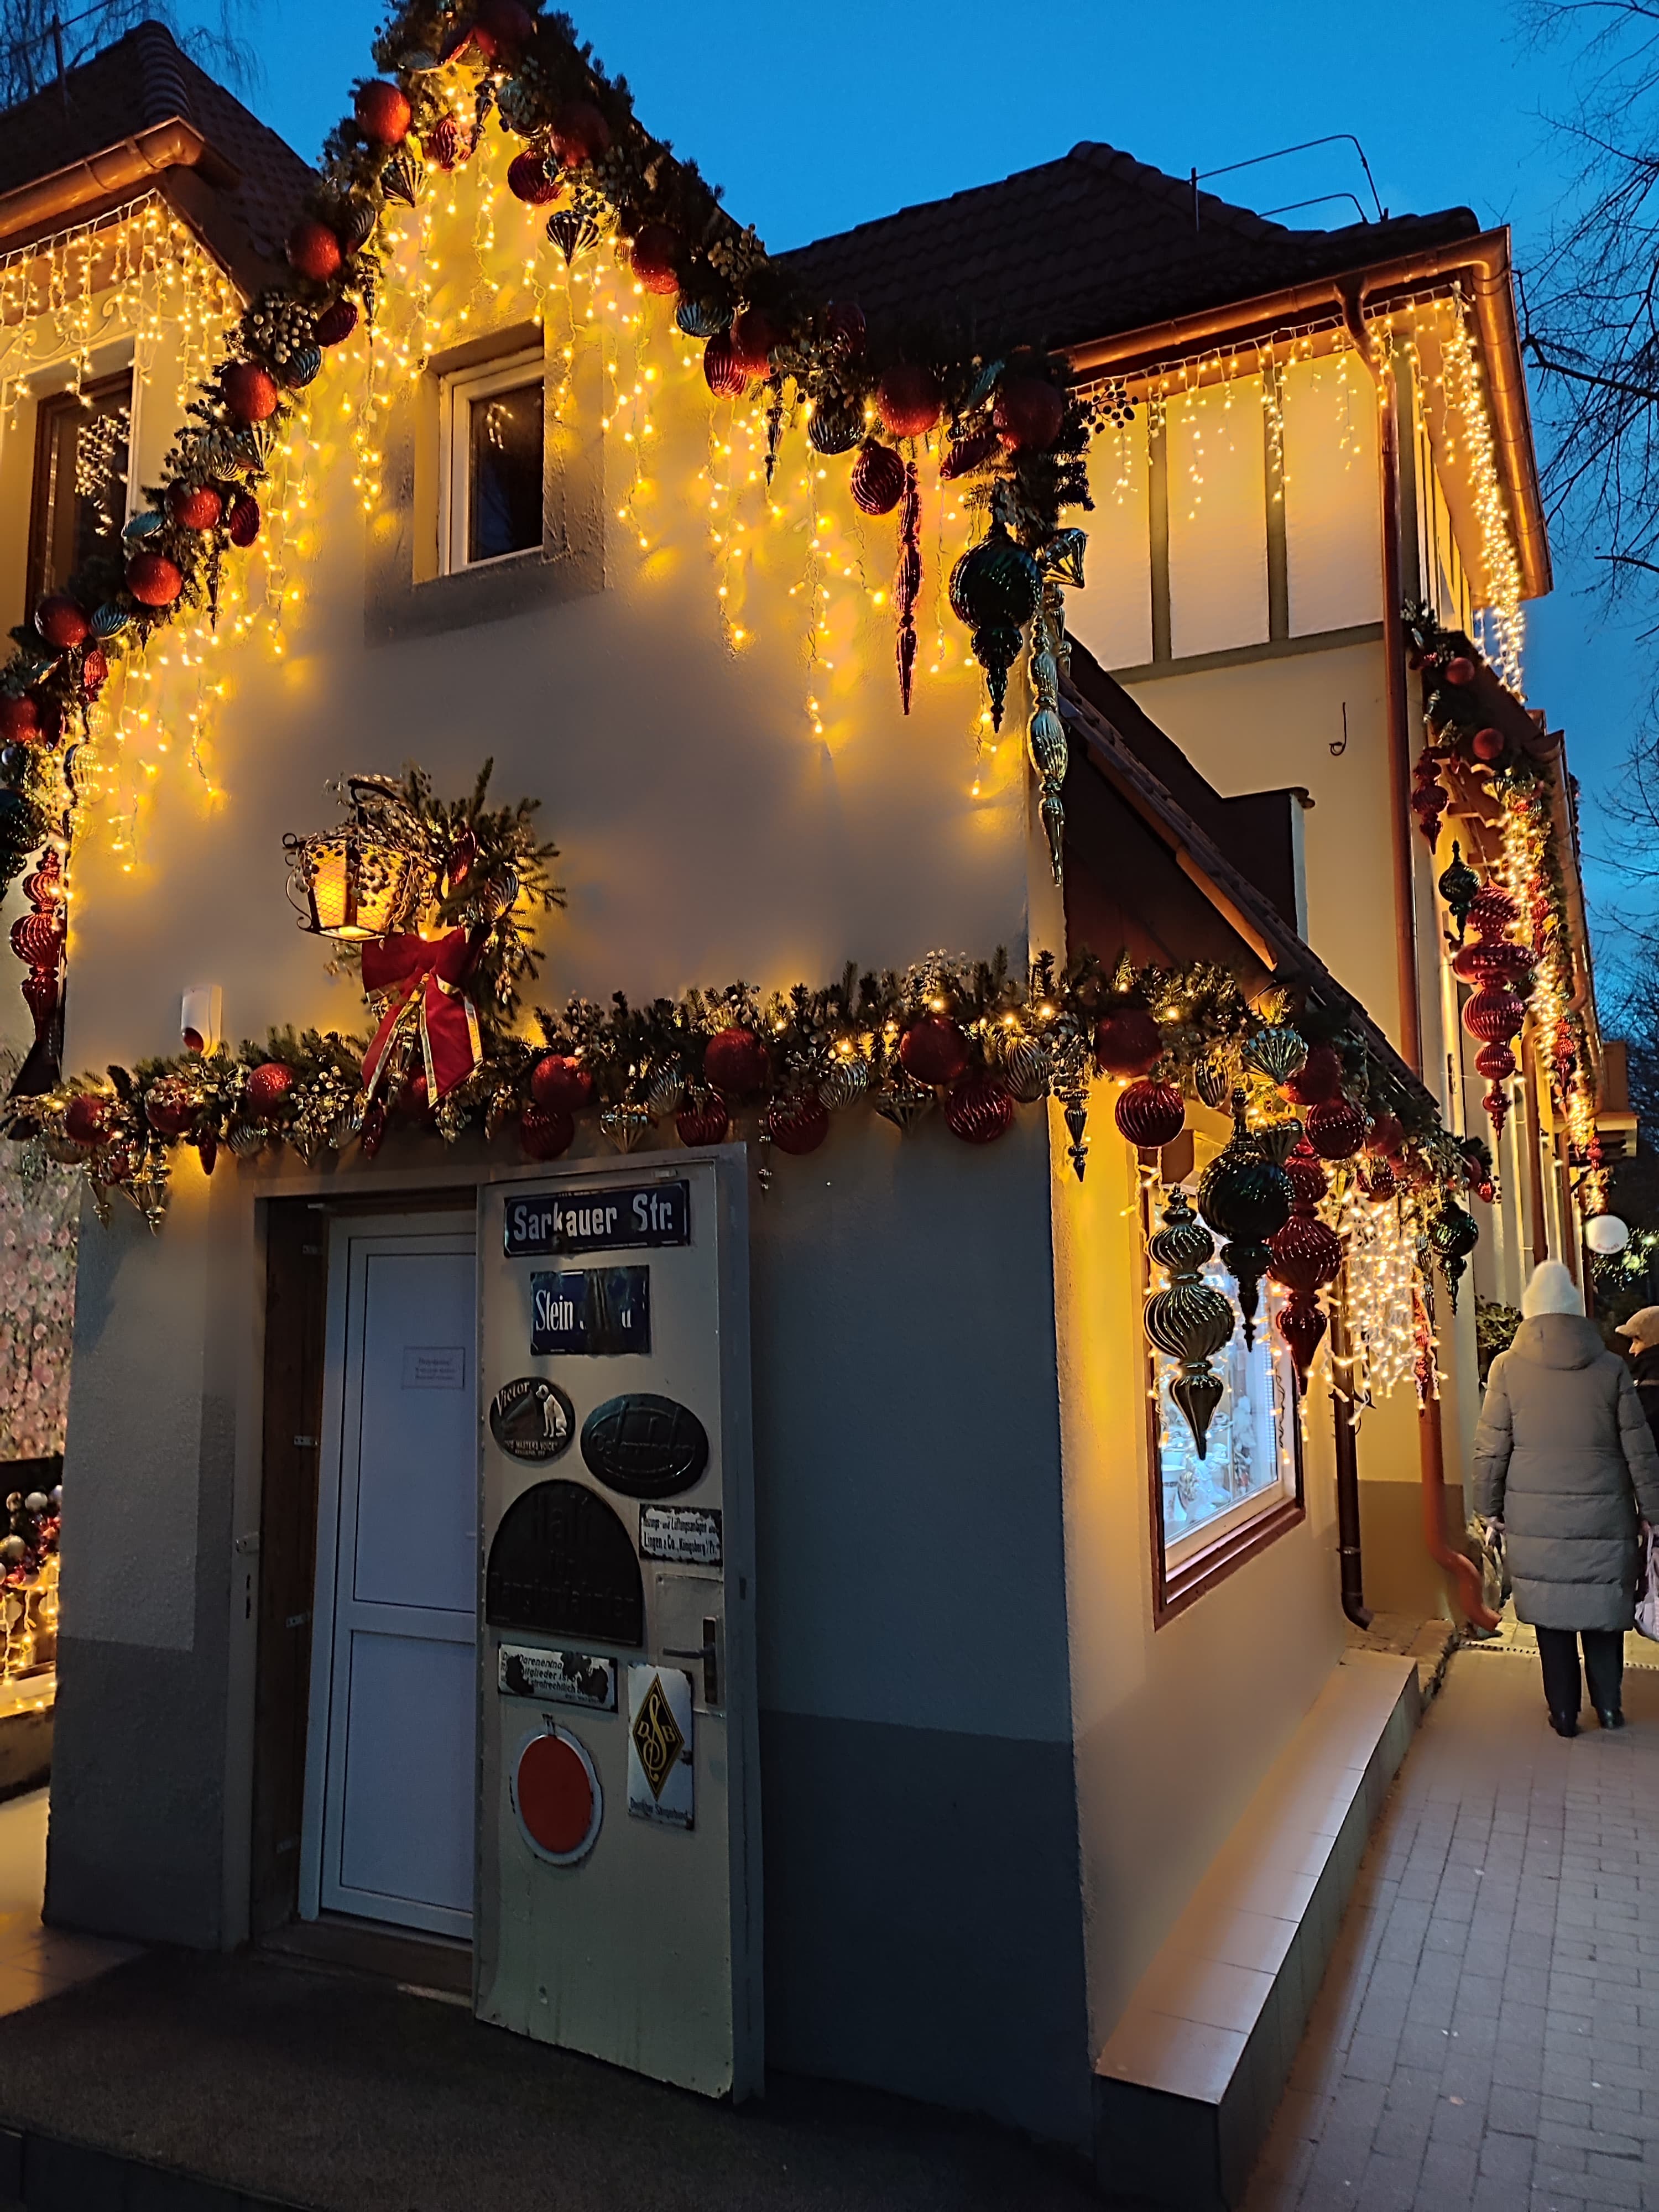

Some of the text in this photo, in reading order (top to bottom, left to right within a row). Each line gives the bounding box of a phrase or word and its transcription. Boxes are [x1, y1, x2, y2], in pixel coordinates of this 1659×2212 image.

[513, 1193, 673, 1241] Sarkauer Str.
[495, 1381, 530, 1416] Victor
